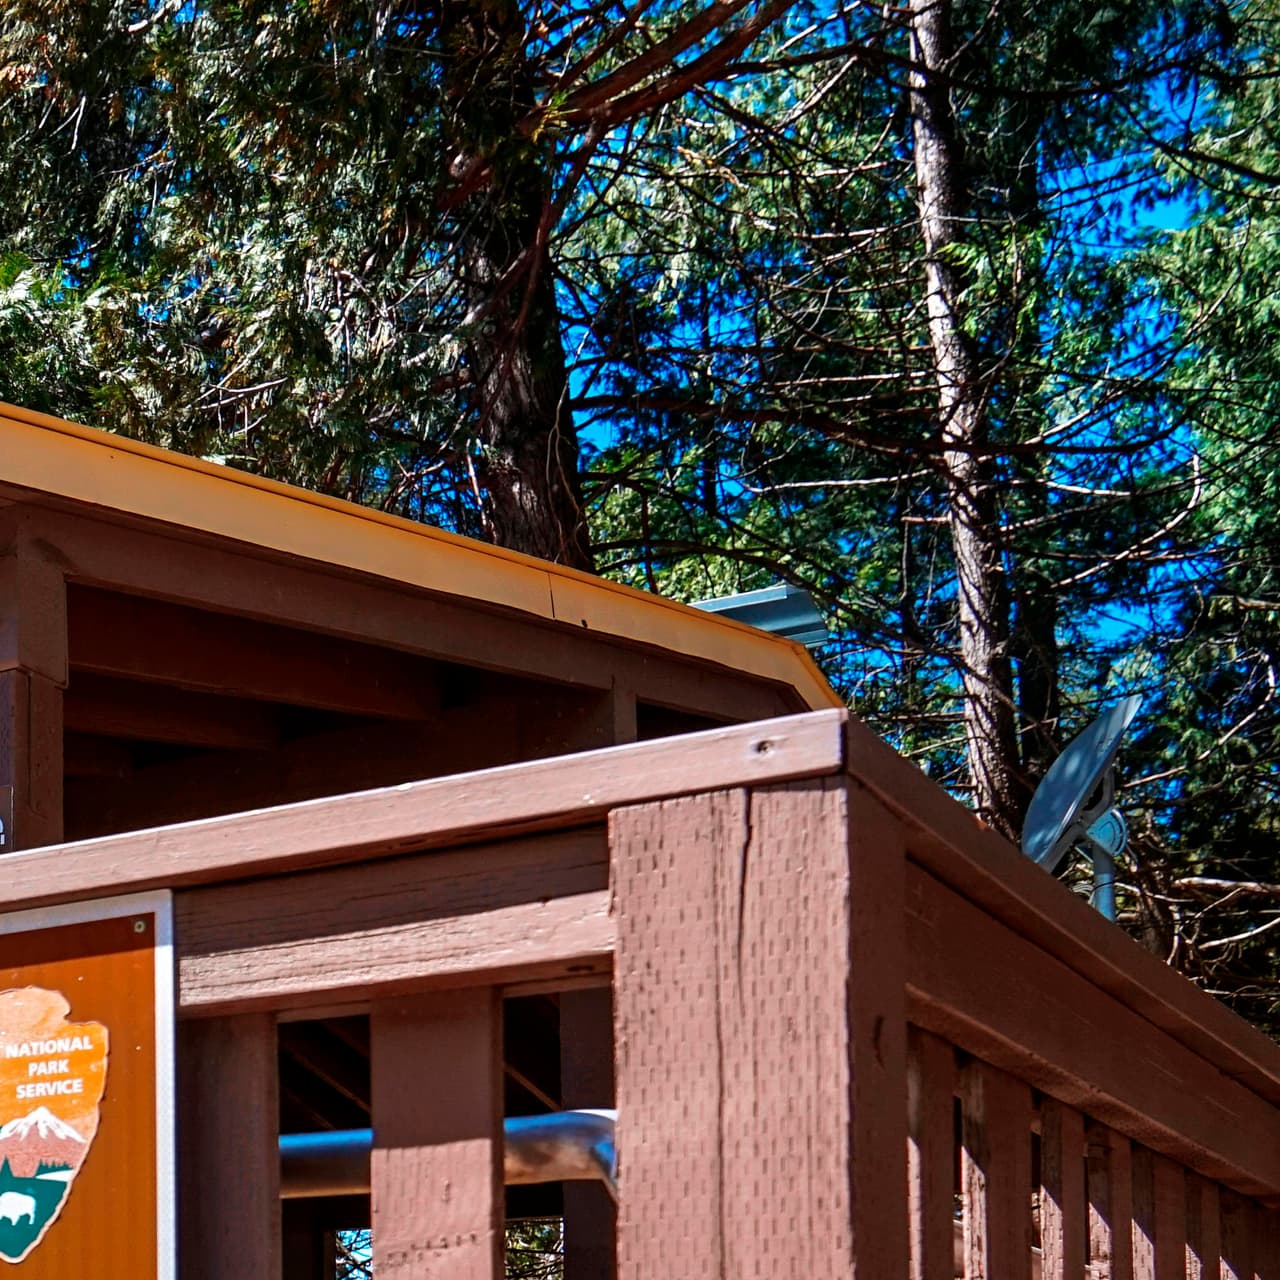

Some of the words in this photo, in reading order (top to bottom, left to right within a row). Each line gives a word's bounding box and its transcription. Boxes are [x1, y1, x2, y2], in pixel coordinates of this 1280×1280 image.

[6, 1036, 93, 1058] NATIONAL
[28, 1059, 69, 1076] PARK
[15, 1079, 83, 1099] SERVICE
